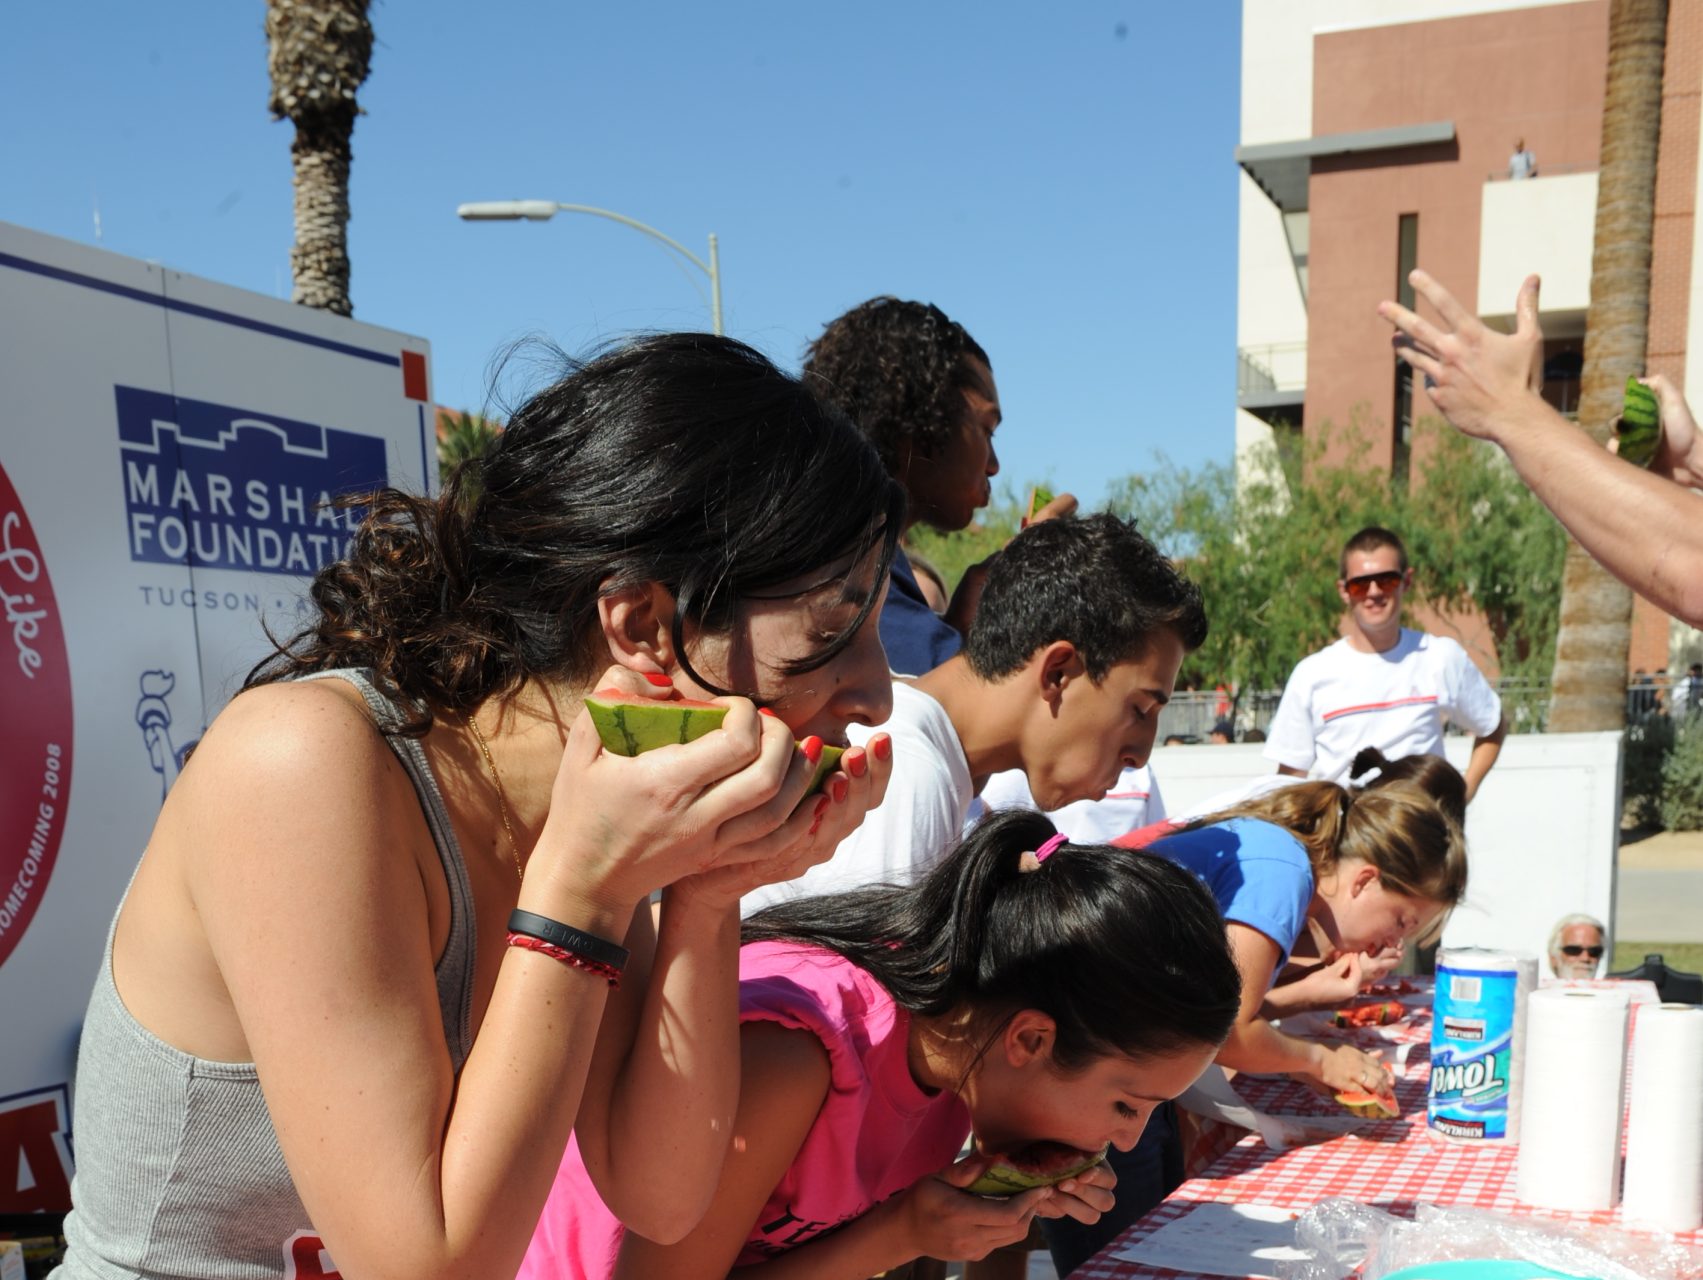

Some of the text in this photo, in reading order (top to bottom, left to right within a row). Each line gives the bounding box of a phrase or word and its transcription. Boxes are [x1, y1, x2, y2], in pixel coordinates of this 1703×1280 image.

[127, 460, 362, 533] MARSHAL
[131, 512, 357, 573] FOUNDATI
[139, 586, 259, 611] TUCSON
[0, 743, 62, 936] OMECOMING 2008
